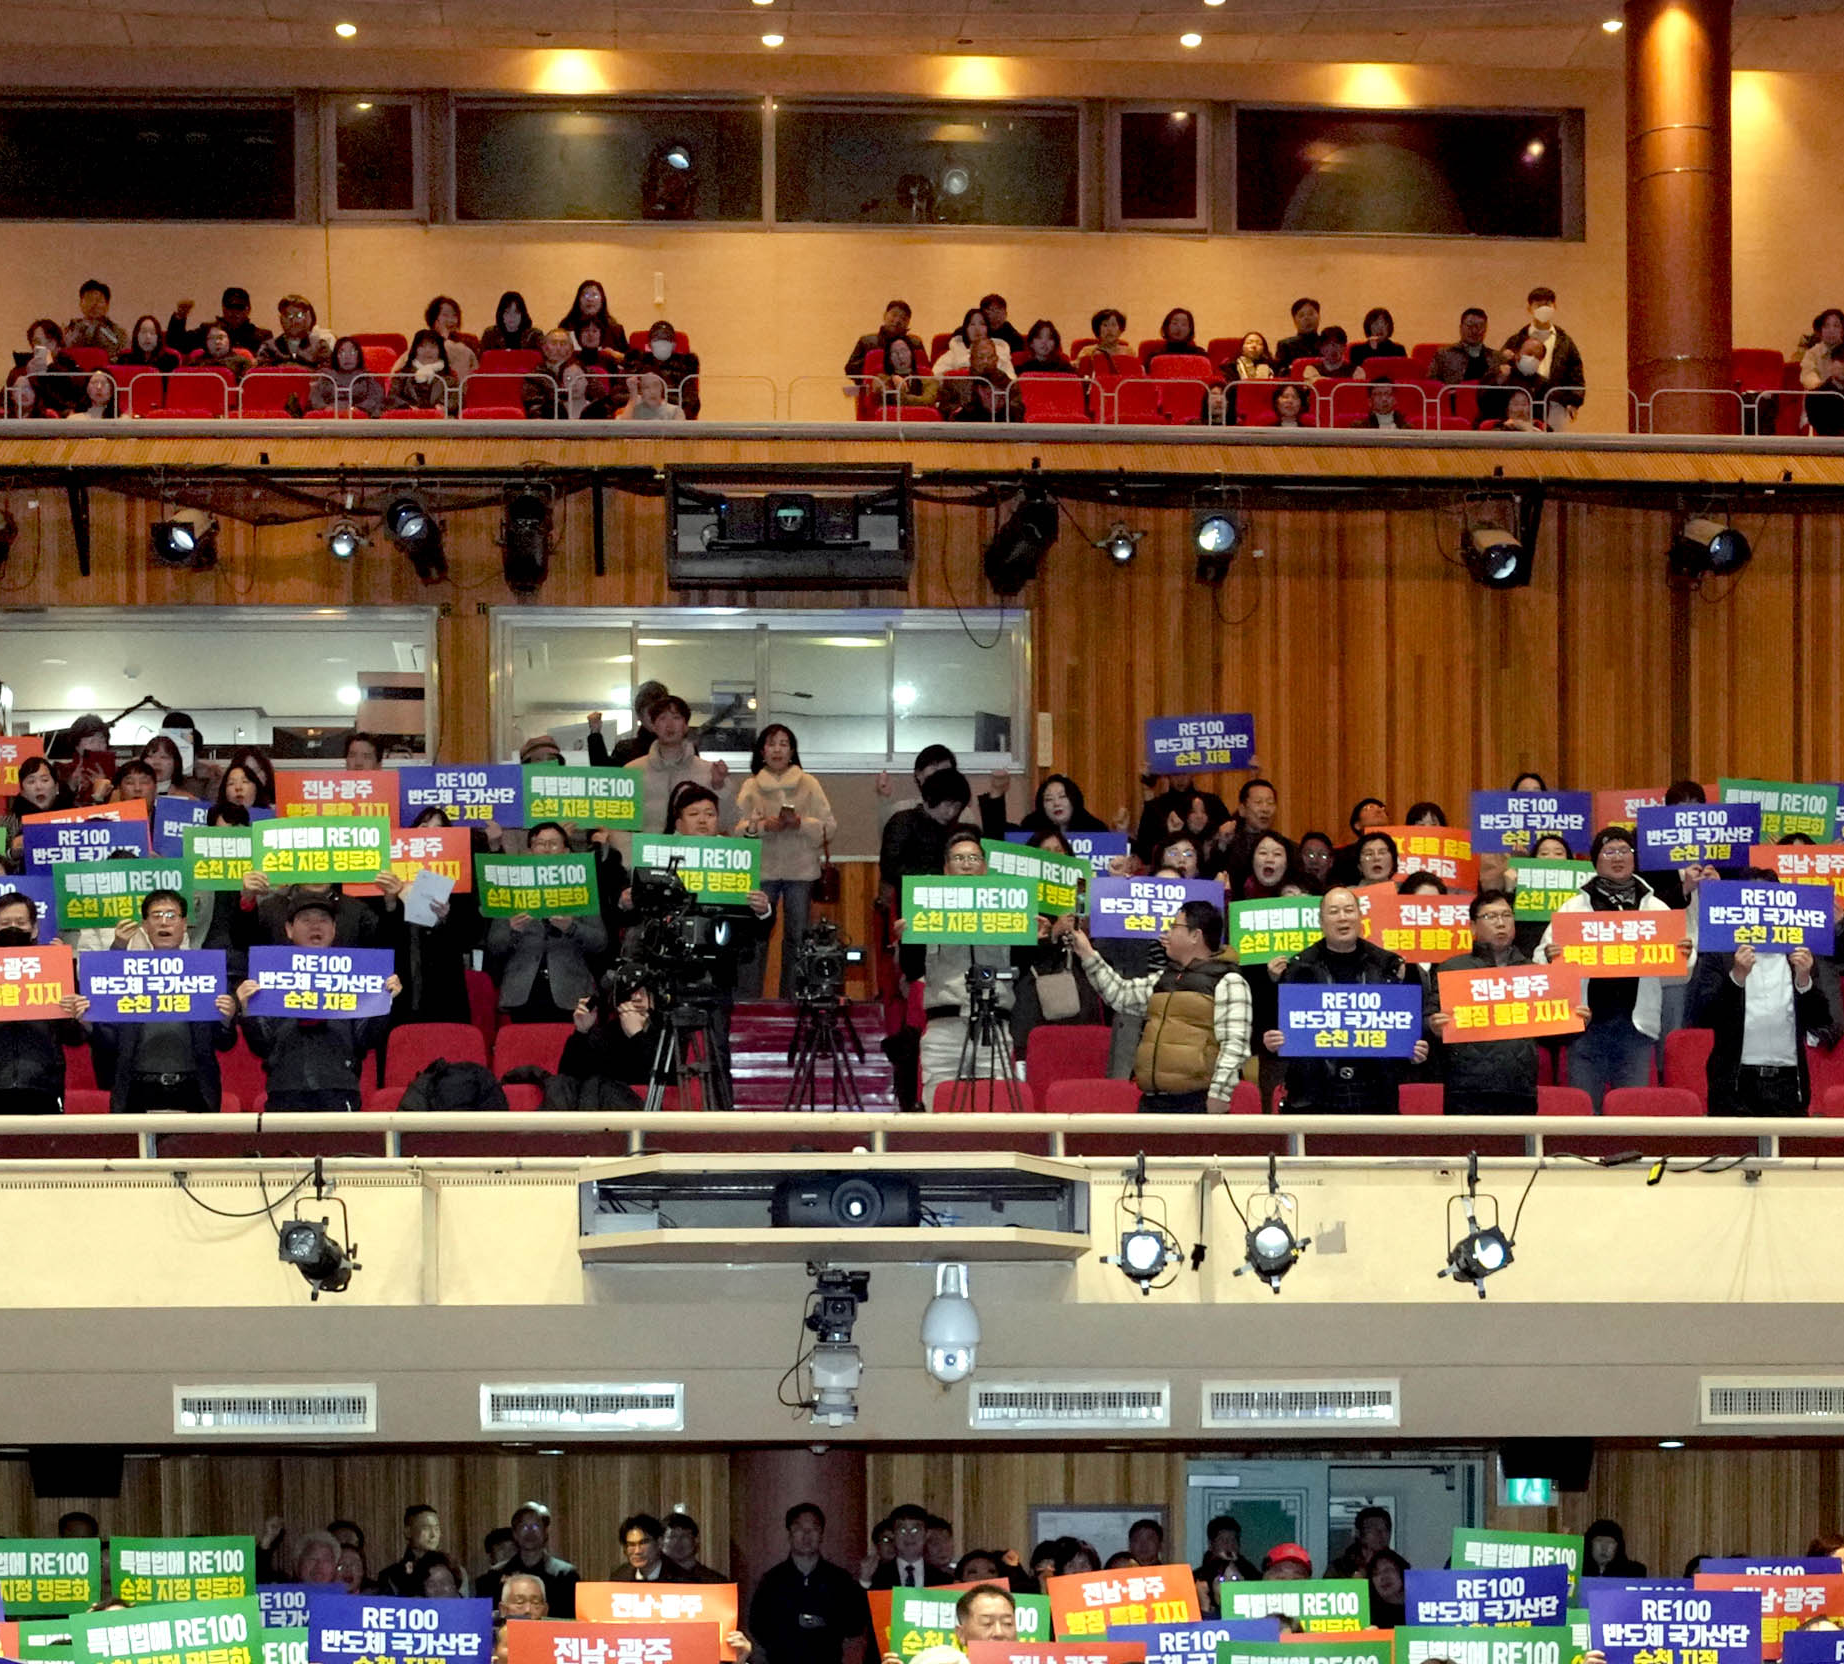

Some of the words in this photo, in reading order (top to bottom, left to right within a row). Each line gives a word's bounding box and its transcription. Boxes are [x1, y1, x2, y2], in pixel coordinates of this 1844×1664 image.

[977, 888, 1027, 908] RE100
[1742, 889, 1796, 907] RE100
[913, 912, 943, 931] 순천
[948, 913, 977, 931] 지정
[982, 913, 1027, 932] 명문화
[1710, 907, 1759, 924] 반도체
[1763, 908, 1826, 927] 국가산단
[1735, 925, 1766, 943] 순천
[1773, 927, 1803, 943] 지정
[1642, 1600, 1711, 1622] RE100
[1603, 1623, 1663, 1646] 반도체
[1668, 1625, 1750, 1647] 국가산단
